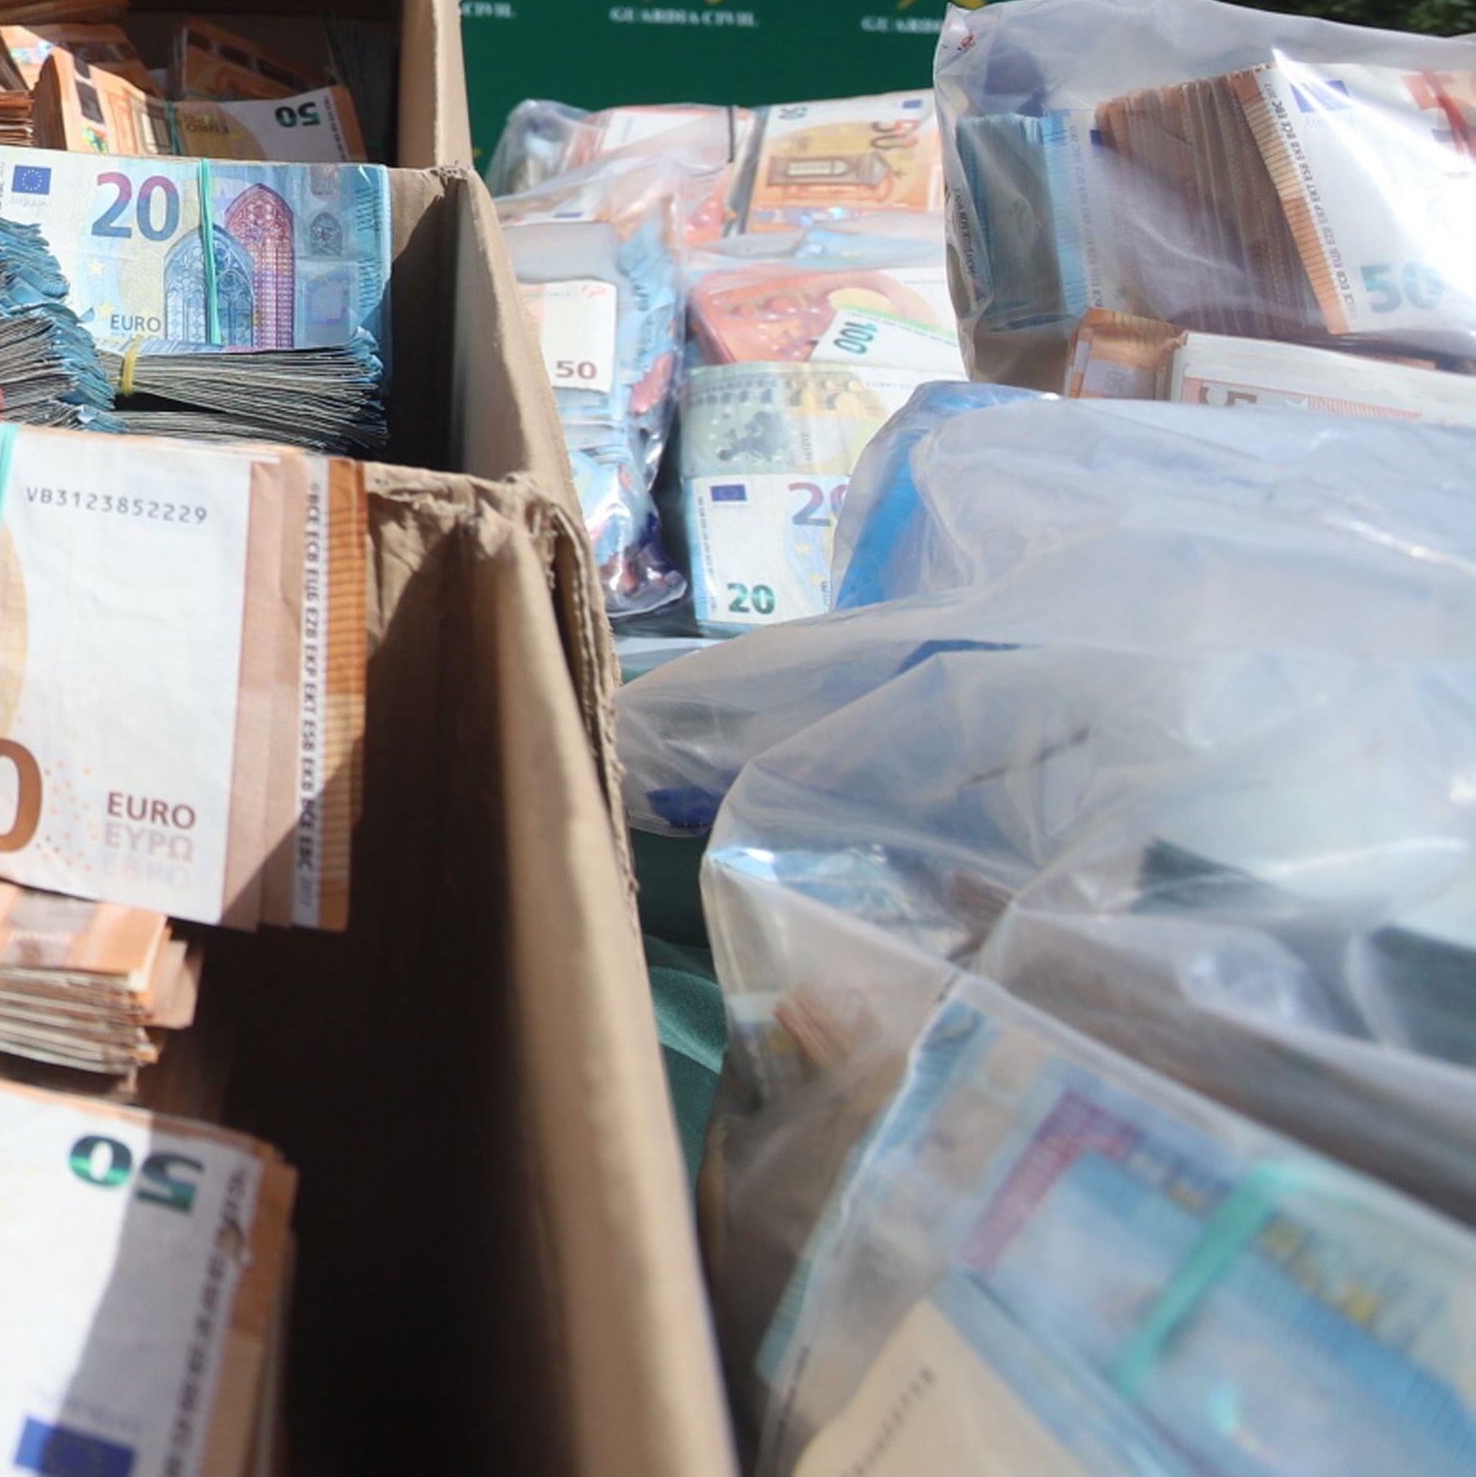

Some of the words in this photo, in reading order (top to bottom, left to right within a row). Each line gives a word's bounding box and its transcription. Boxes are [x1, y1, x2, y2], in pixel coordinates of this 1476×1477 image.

[275, 101, 321, 128] 50
[90, 172, 180, 242] 20
[110, 313, 162, 333] EURO
[835, 321, 878, 356] 100
[554, 360, 598, 381] 50
[24, 484, 210, 524] VB3123852229
[727, 583, 776, 616] 20
[107, 791, 196, 830] EURO
[68, 1134, 206, 1216] 50
